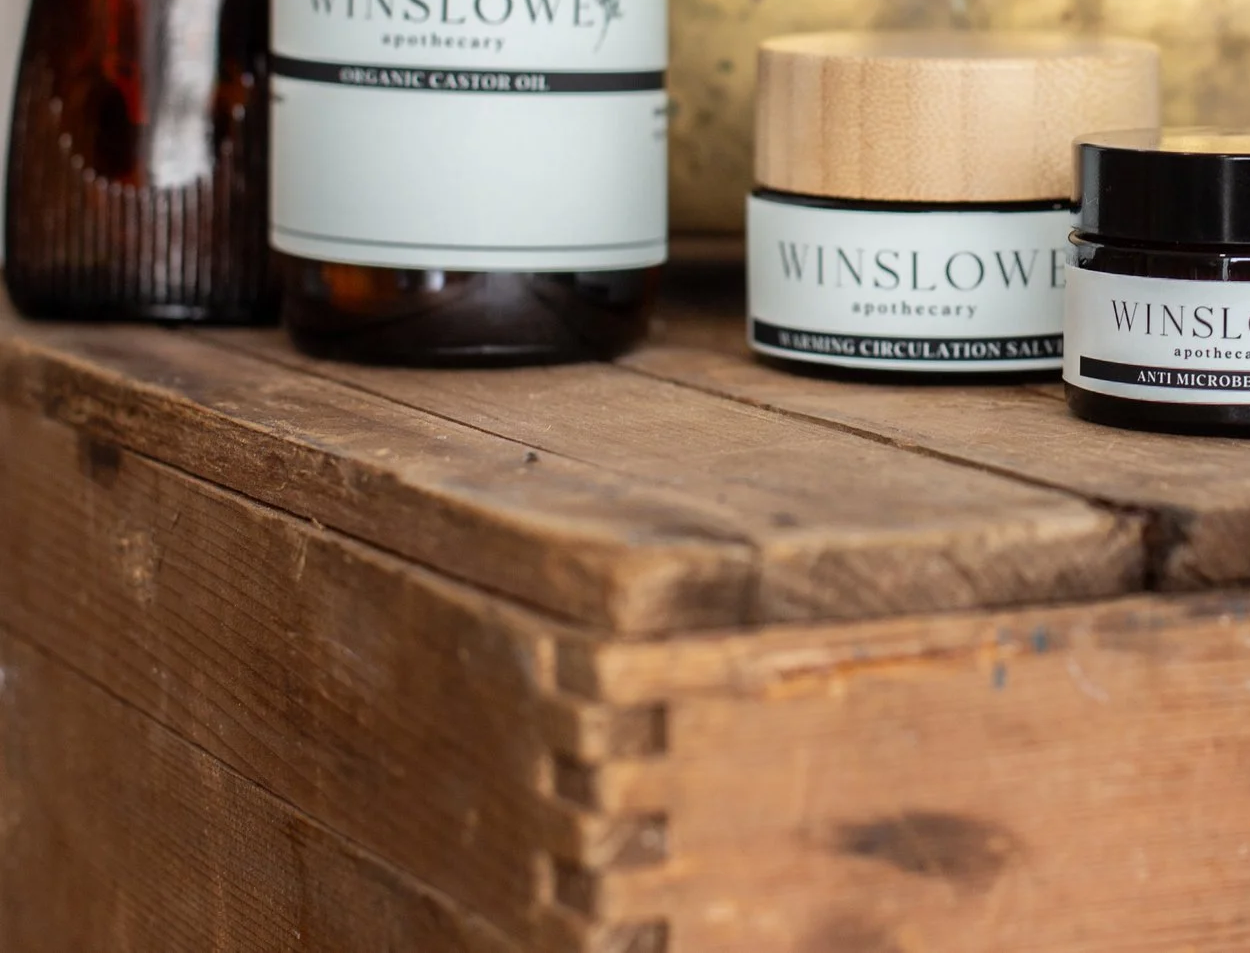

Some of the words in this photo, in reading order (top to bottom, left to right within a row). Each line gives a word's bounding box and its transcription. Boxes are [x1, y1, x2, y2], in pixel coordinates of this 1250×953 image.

[380, 31, 506, 53] apothecary
[339, 67, 425, 88] ORGANIC
[428, 72, 511, 91] CASTOR
[514, 74, 549, 92] OIL
[851, 299, 979, 320] apothecary
[778, 330, 856, 356] WARMING
[860, 338, 1001, 360] CIRCULATION
[1137, 370, 1172, 385] ANTI
